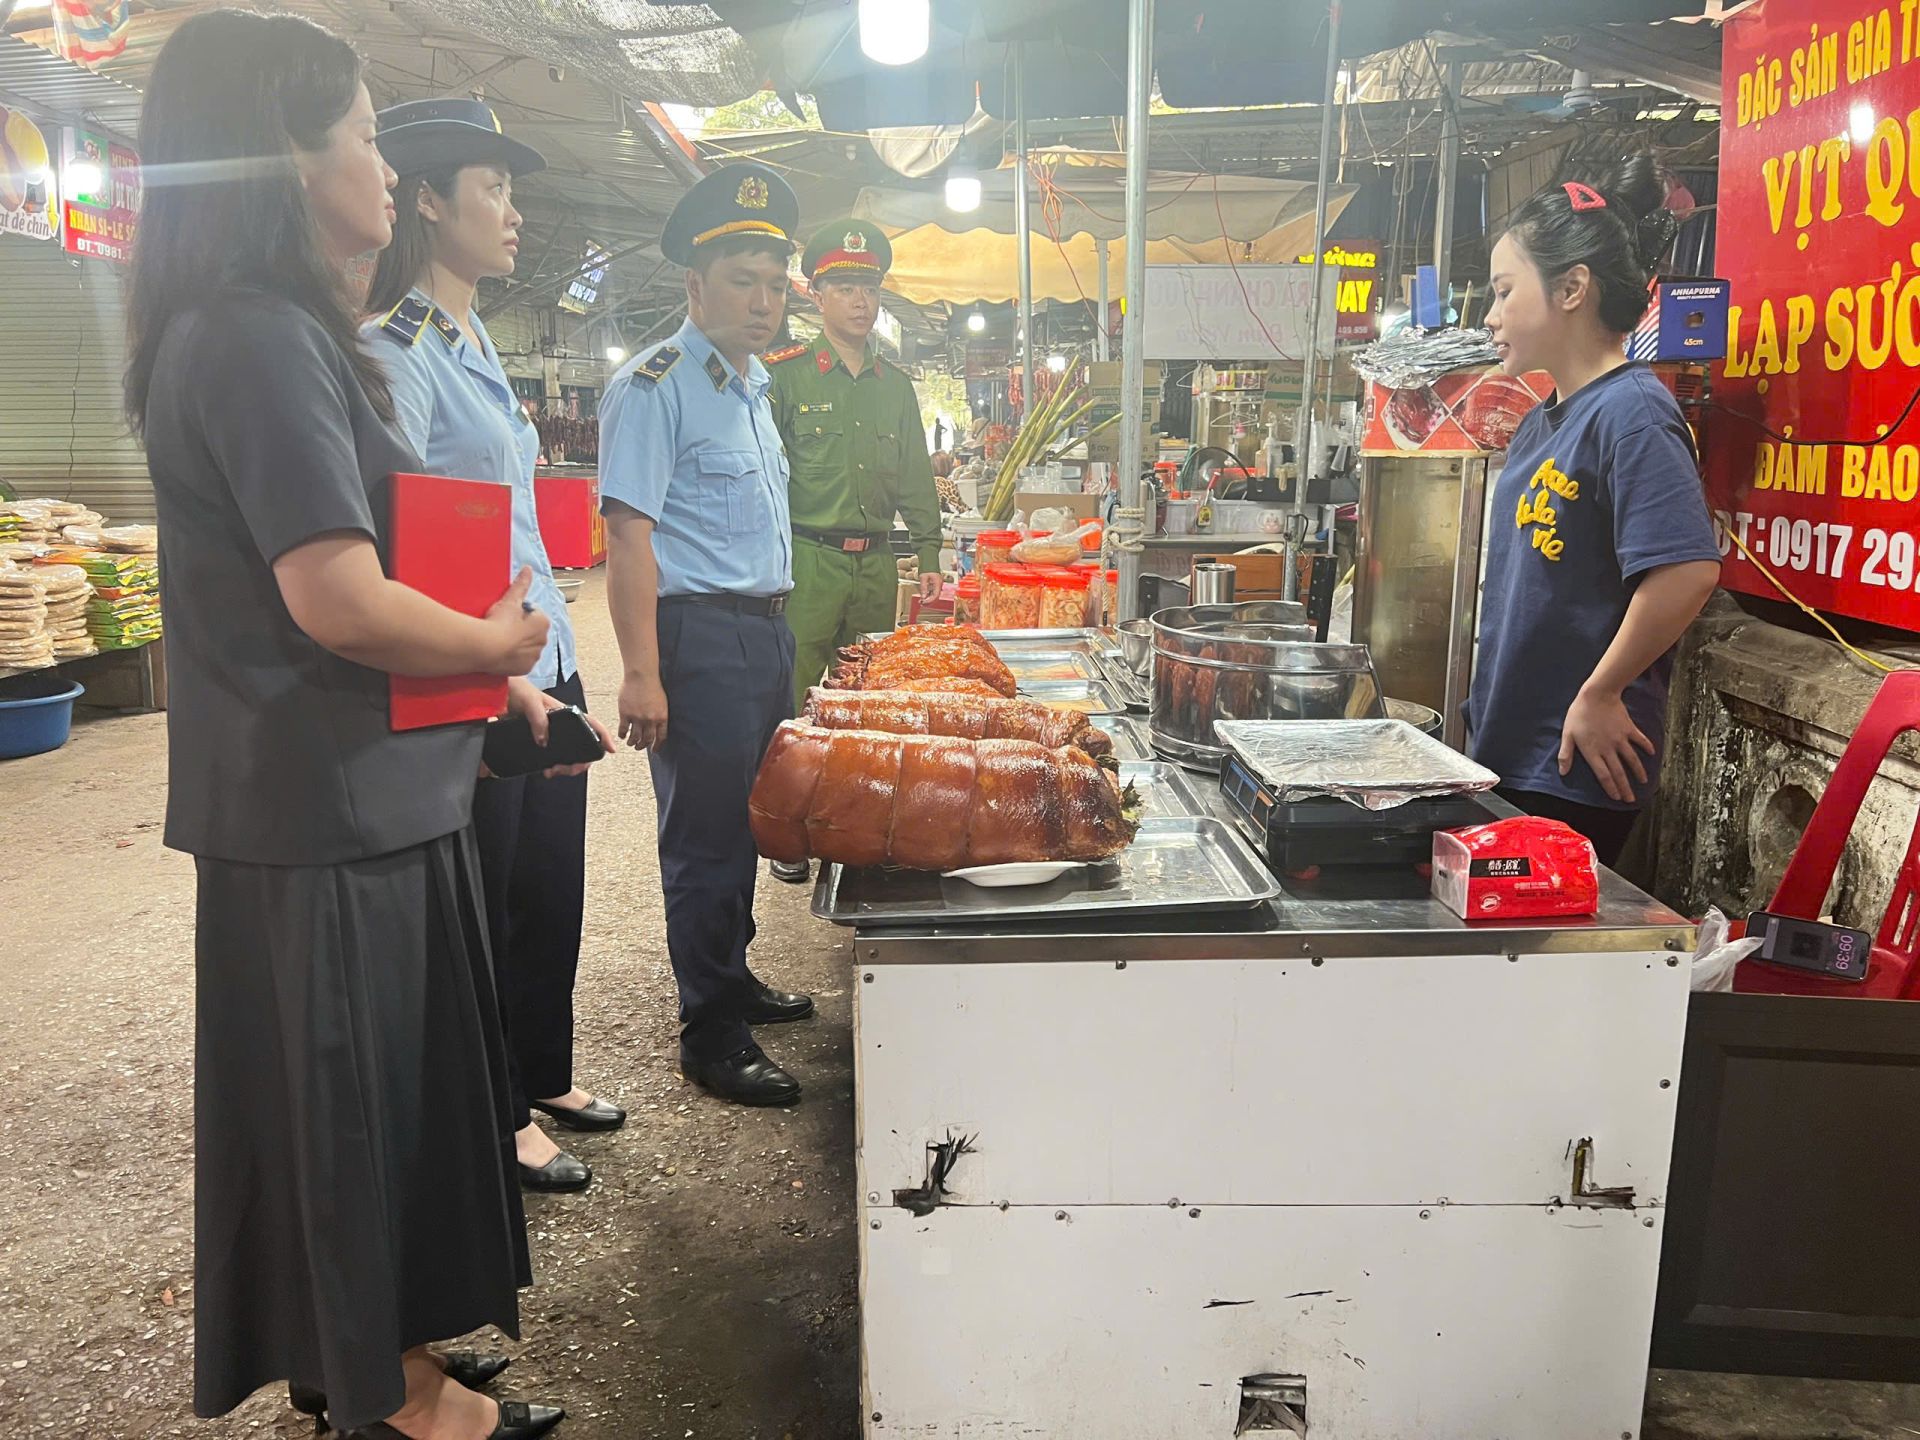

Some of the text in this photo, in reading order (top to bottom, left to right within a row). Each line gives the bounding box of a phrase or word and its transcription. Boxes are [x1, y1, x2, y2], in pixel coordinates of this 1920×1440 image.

[1737, 0, 1920, 131] ĐẶC SẢN GIA T
[1762, 133, 1850, 251] VỊT
[1671, 287, 1721, 296] ANNAPURNA
[1724, 294, 1815, 395] LẠP
[1754, 424, 1919, 502] ĐẢM BẢO
[1860, 528, 1920, 595] 29
[1835, 935, 1853, 970] 09:39
